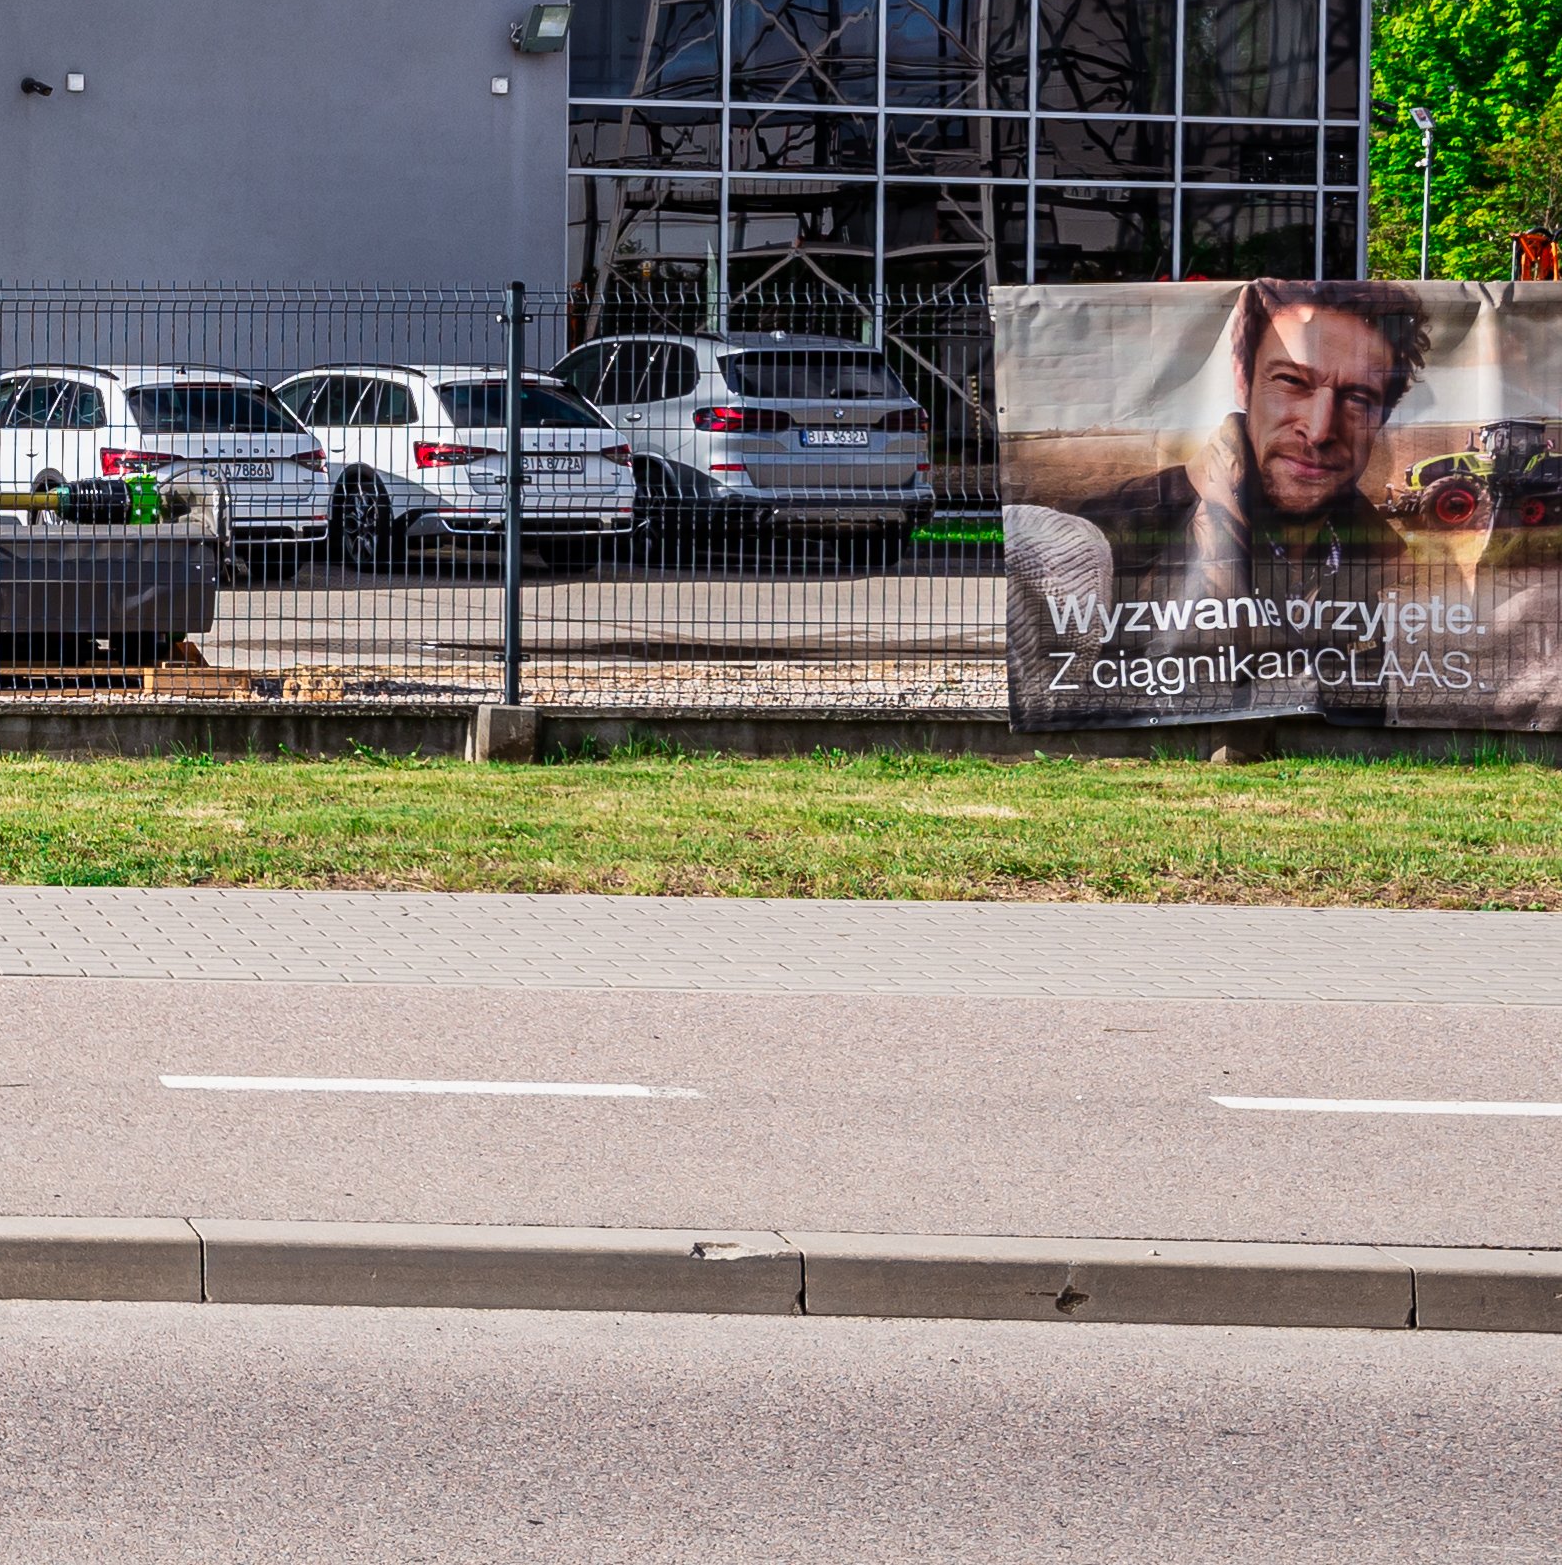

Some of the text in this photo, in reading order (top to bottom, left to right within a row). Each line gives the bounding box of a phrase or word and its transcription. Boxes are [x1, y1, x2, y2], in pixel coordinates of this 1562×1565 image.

[1046, 588, 1281, 643] Wyzwanie
[1049, 652, 1079, 690] Z
[1315, 647, 1486, 689] CLAAS.
